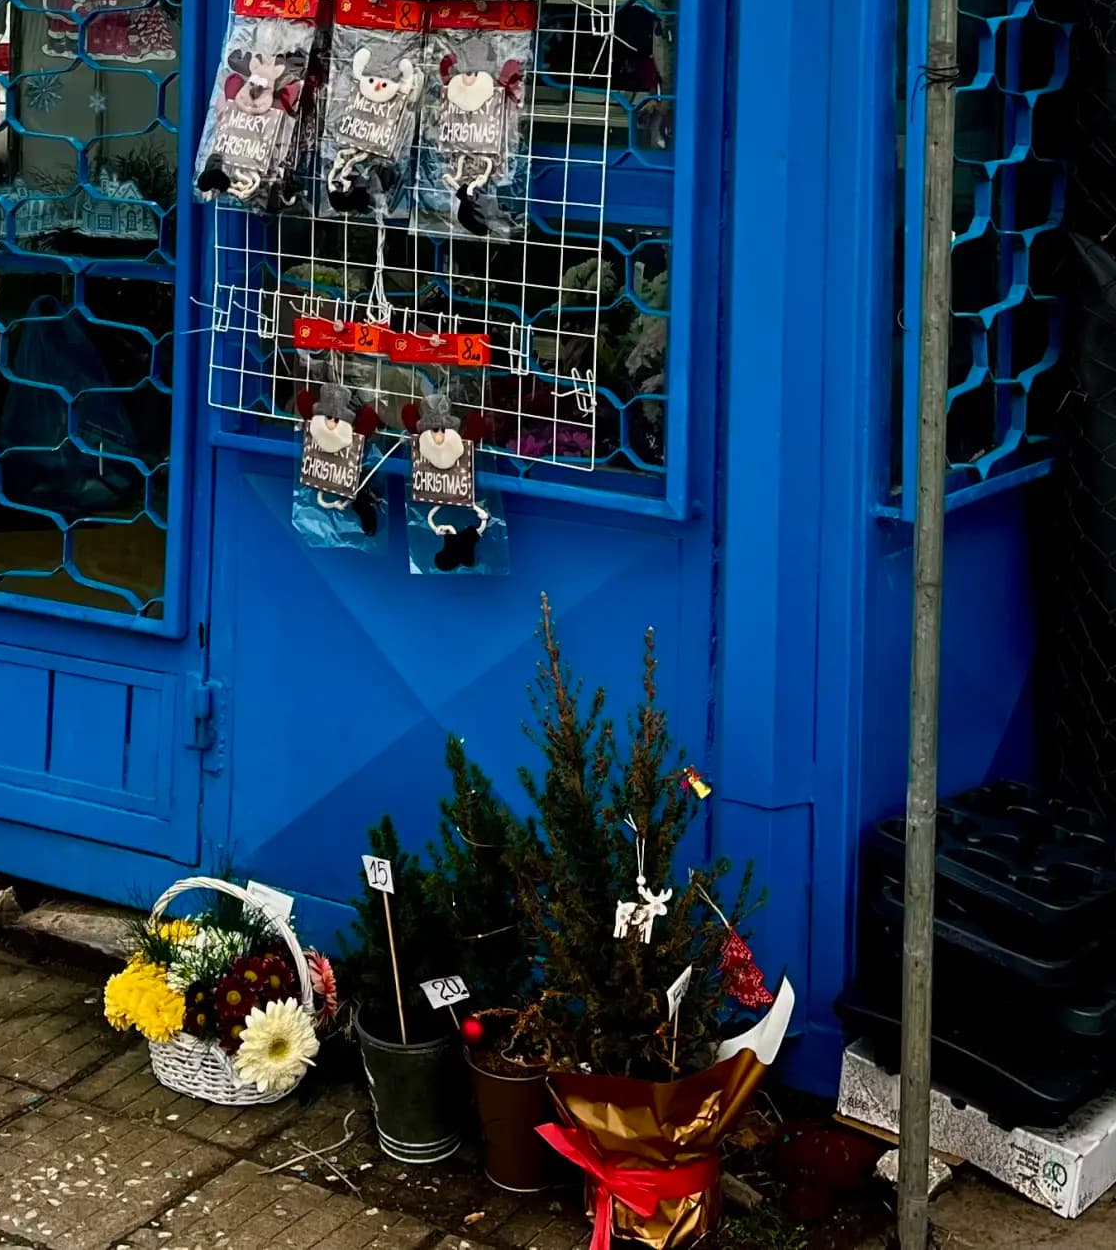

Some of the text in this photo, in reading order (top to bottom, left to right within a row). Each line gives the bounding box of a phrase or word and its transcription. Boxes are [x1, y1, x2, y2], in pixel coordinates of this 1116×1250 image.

[228, 110, 270, 134] MERRY
[340, 116, 391, 146] CHRISTMAS
[441, 122, 496, 143] CHRISTMAS
[215, 134, 267, 161] CHRISTMAS
[302, 456, 355, 488] CHRISTMAS
[415, 471, 469, 496] CHRISTMAS
[369, 860, 389, 886] 15
